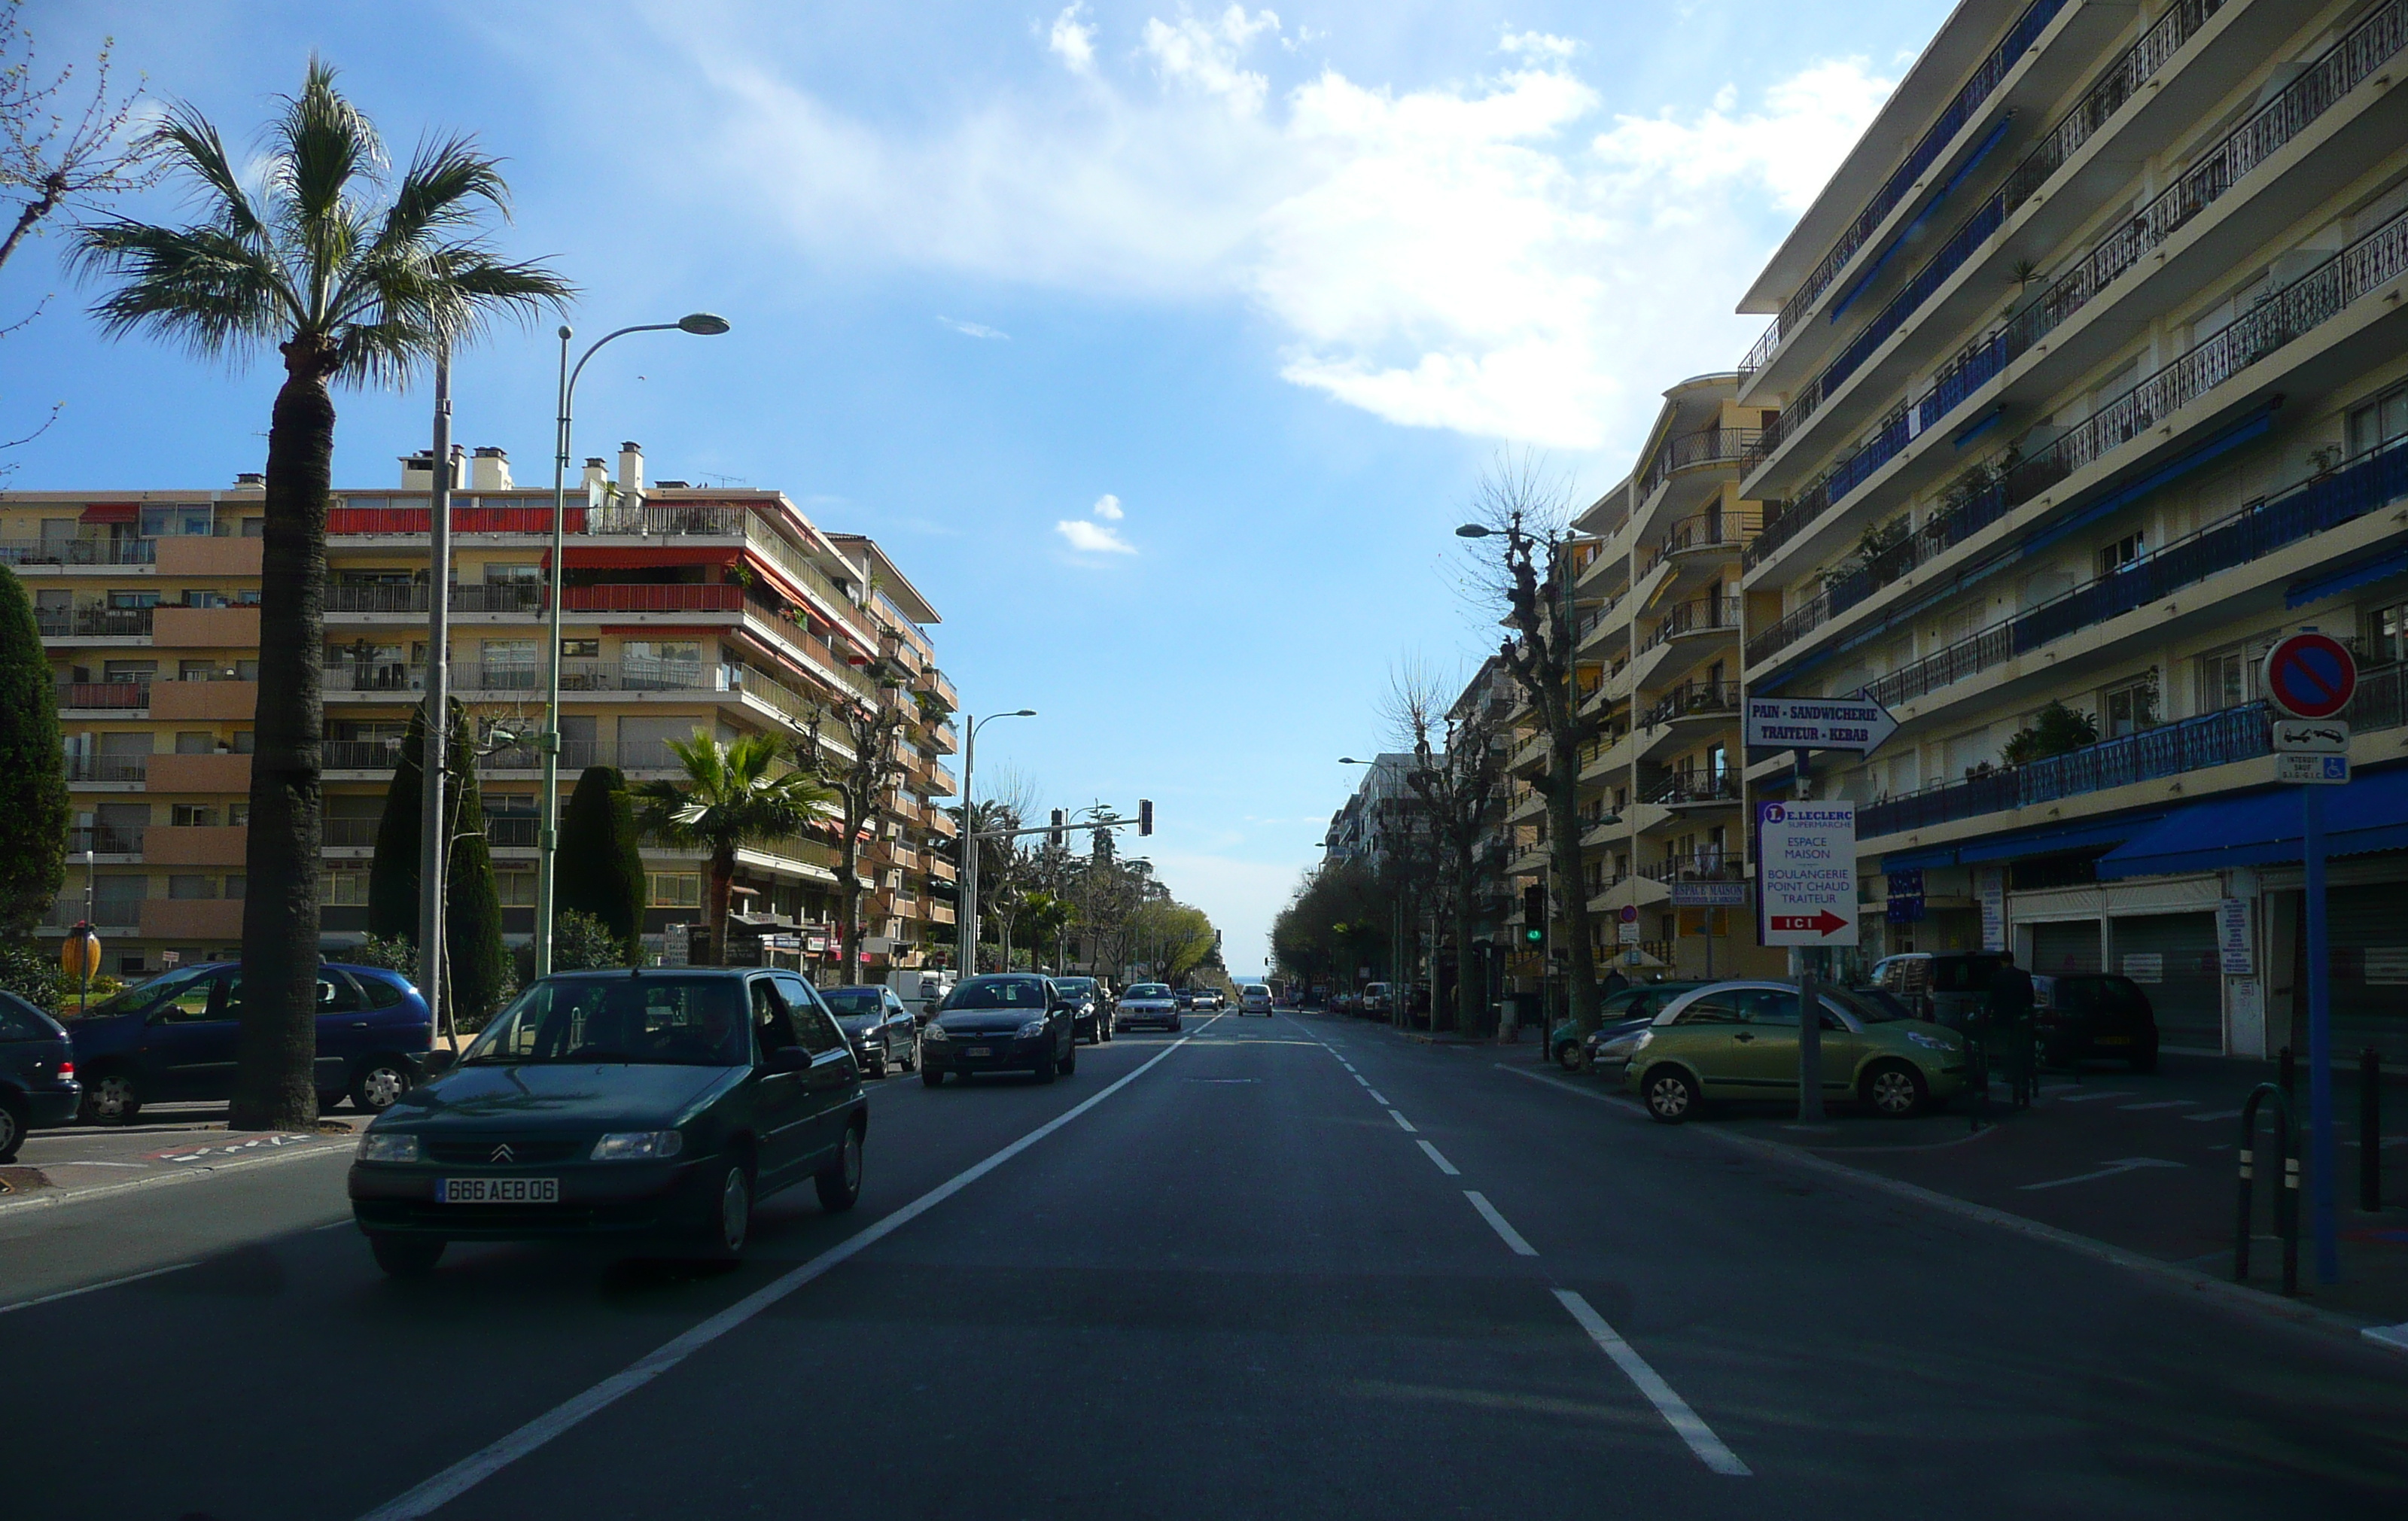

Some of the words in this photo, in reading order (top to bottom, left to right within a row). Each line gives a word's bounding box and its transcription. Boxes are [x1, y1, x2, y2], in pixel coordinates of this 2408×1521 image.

[1752, 704, 1779, 719] PAIN
[1790, 706, 1878, 721] SANDWICHERIE
[1761, 726, 1819, 740] TRAITEUR
[1829, 728, 1868, 742] KEBAB
[1787, 811, 1852, 820] E.LECLERC
[1788, 837, 1828, 847] ESPACE
[1785, 850, 1831, 859] MAISON
[1767, 869, 1849, 879] BOULANGERIE
[1675, 884, 1706, 896] ESPACE
[1709, 884, 1743, 896] MAISON
[1767, 881, 1804, 891] POINT
[1807, 881, 1849, 891] CHAUD
[1782, 894, 1837, 903] TRAITEUR
[1785, 918, 1813, 928] ICI
[449, 1180, 485, 1200] 666
[489, 1180, 525, 1200] AEB
[530, 1180, 554, 1200] 06
